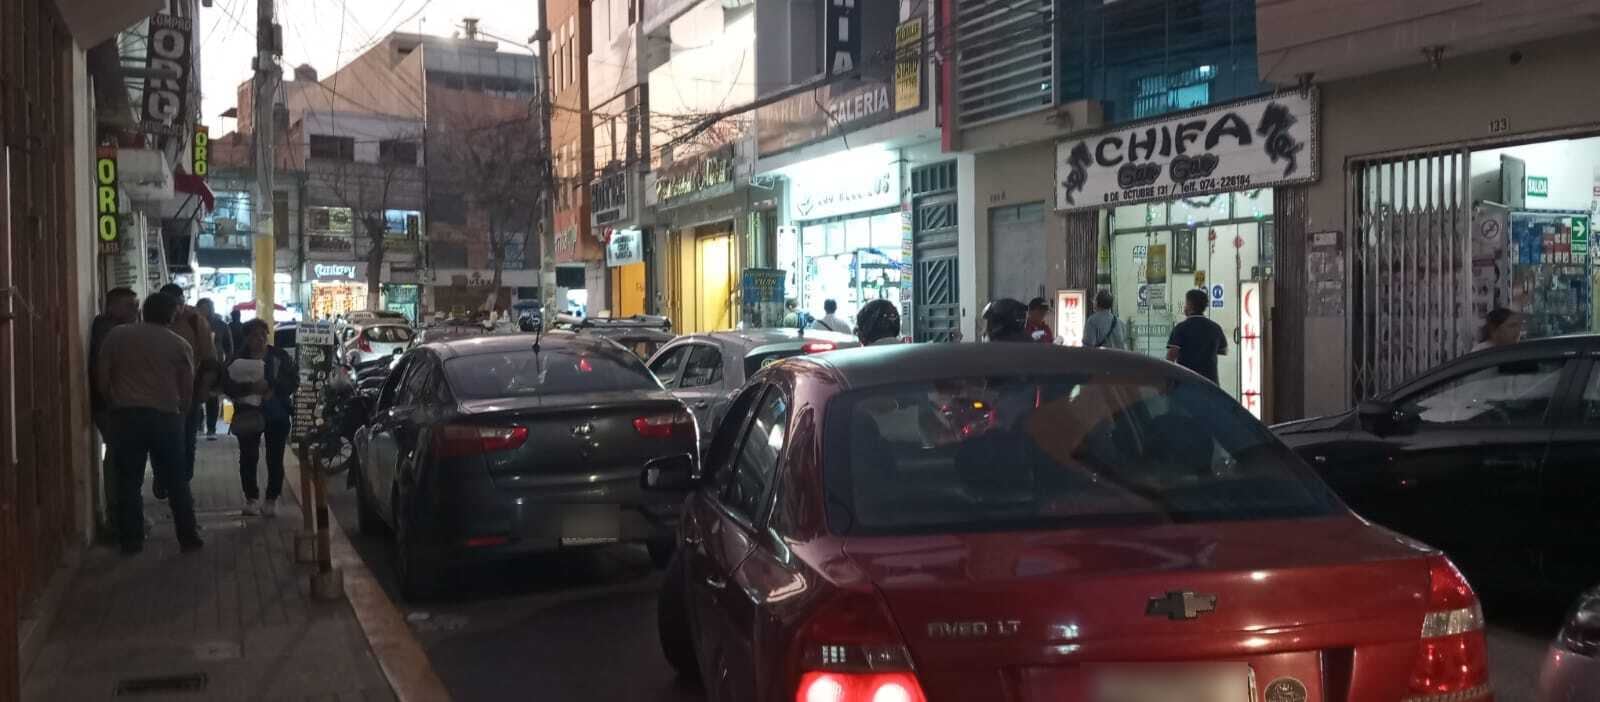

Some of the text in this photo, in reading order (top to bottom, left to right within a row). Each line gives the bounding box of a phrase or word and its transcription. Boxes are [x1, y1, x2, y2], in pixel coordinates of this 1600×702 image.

[828, 85, 889, 127] GALERIA
[194, 131, 207, 176] ORO
[1095, 112, 1252, 167] CHIFA
[98, 158, 117, 241] ORO
[1110, 191, 1119, 201] DE
[1123, 186, 1155, 200] OCTUBRE
[1528, 179, 1547, 193] SALIDA
[998, 620, 1022, 634] LT
